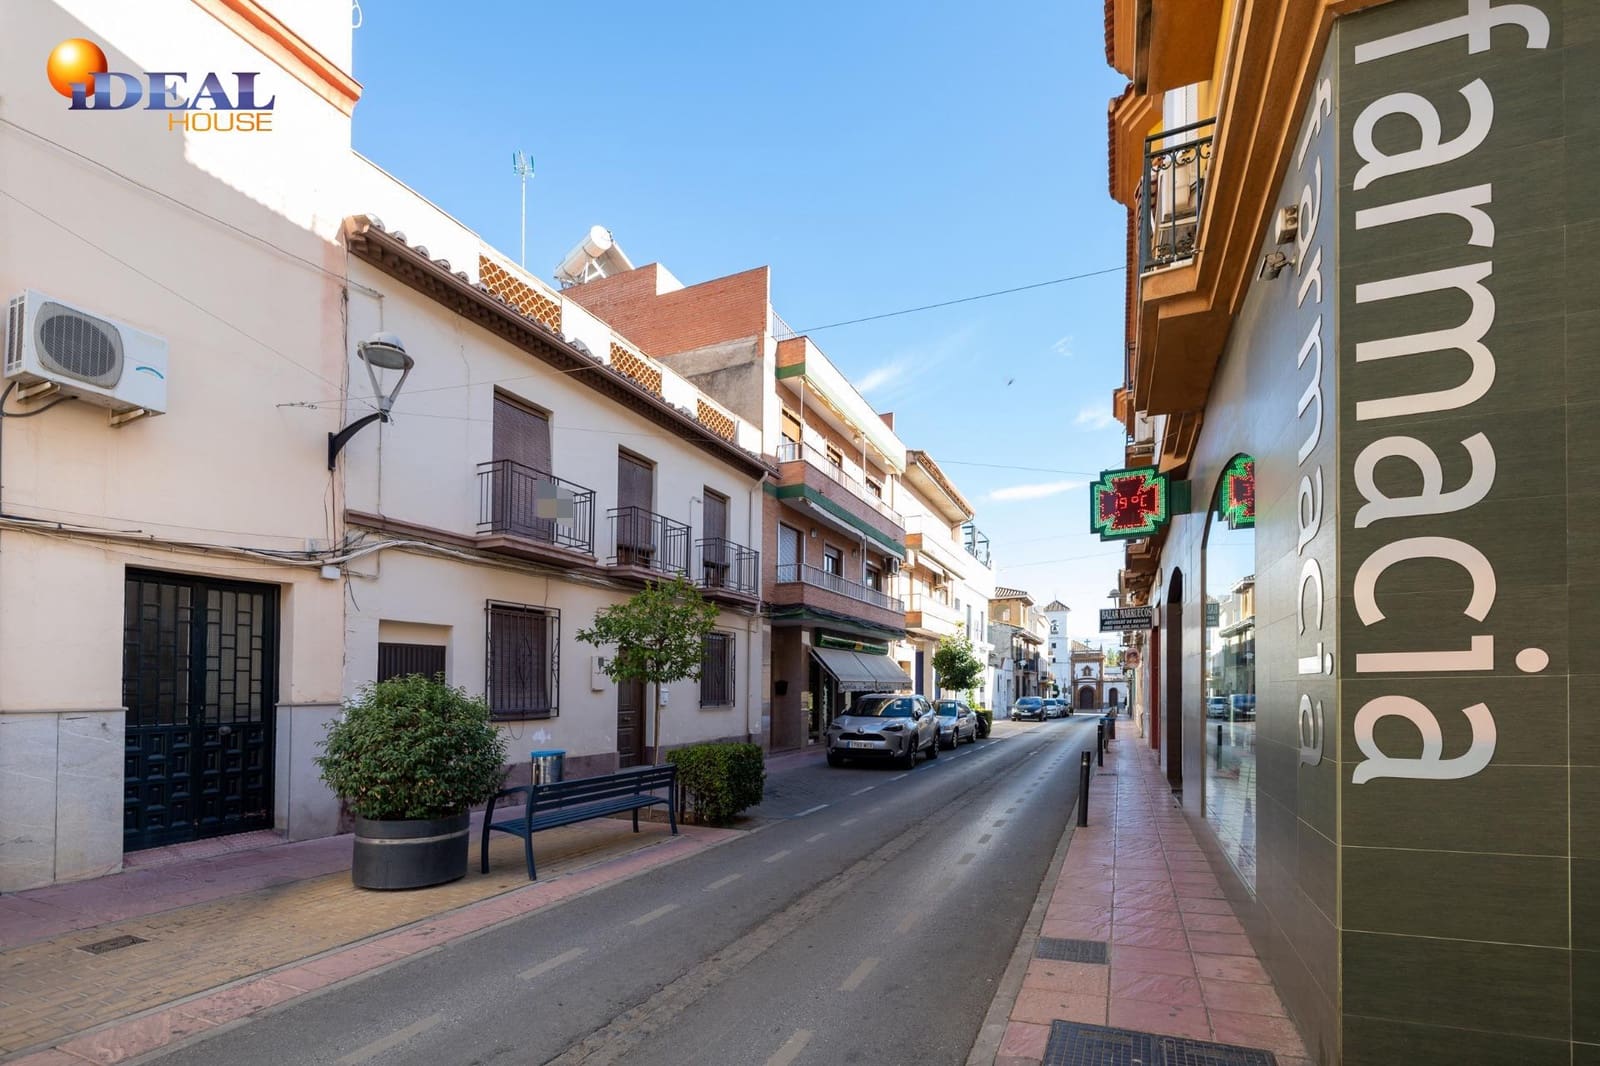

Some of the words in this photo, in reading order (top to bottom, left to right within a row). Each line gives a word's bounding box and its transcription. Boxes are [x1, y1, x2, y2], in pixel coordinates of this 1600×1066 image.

[1102, 610, 1119, 620] BAZAR
[1120, 608, 1152, 619] MARRUECOS
[1298, 77, 1333, 767] farmacia
[1352, 0, 1550, 784] farmacia
